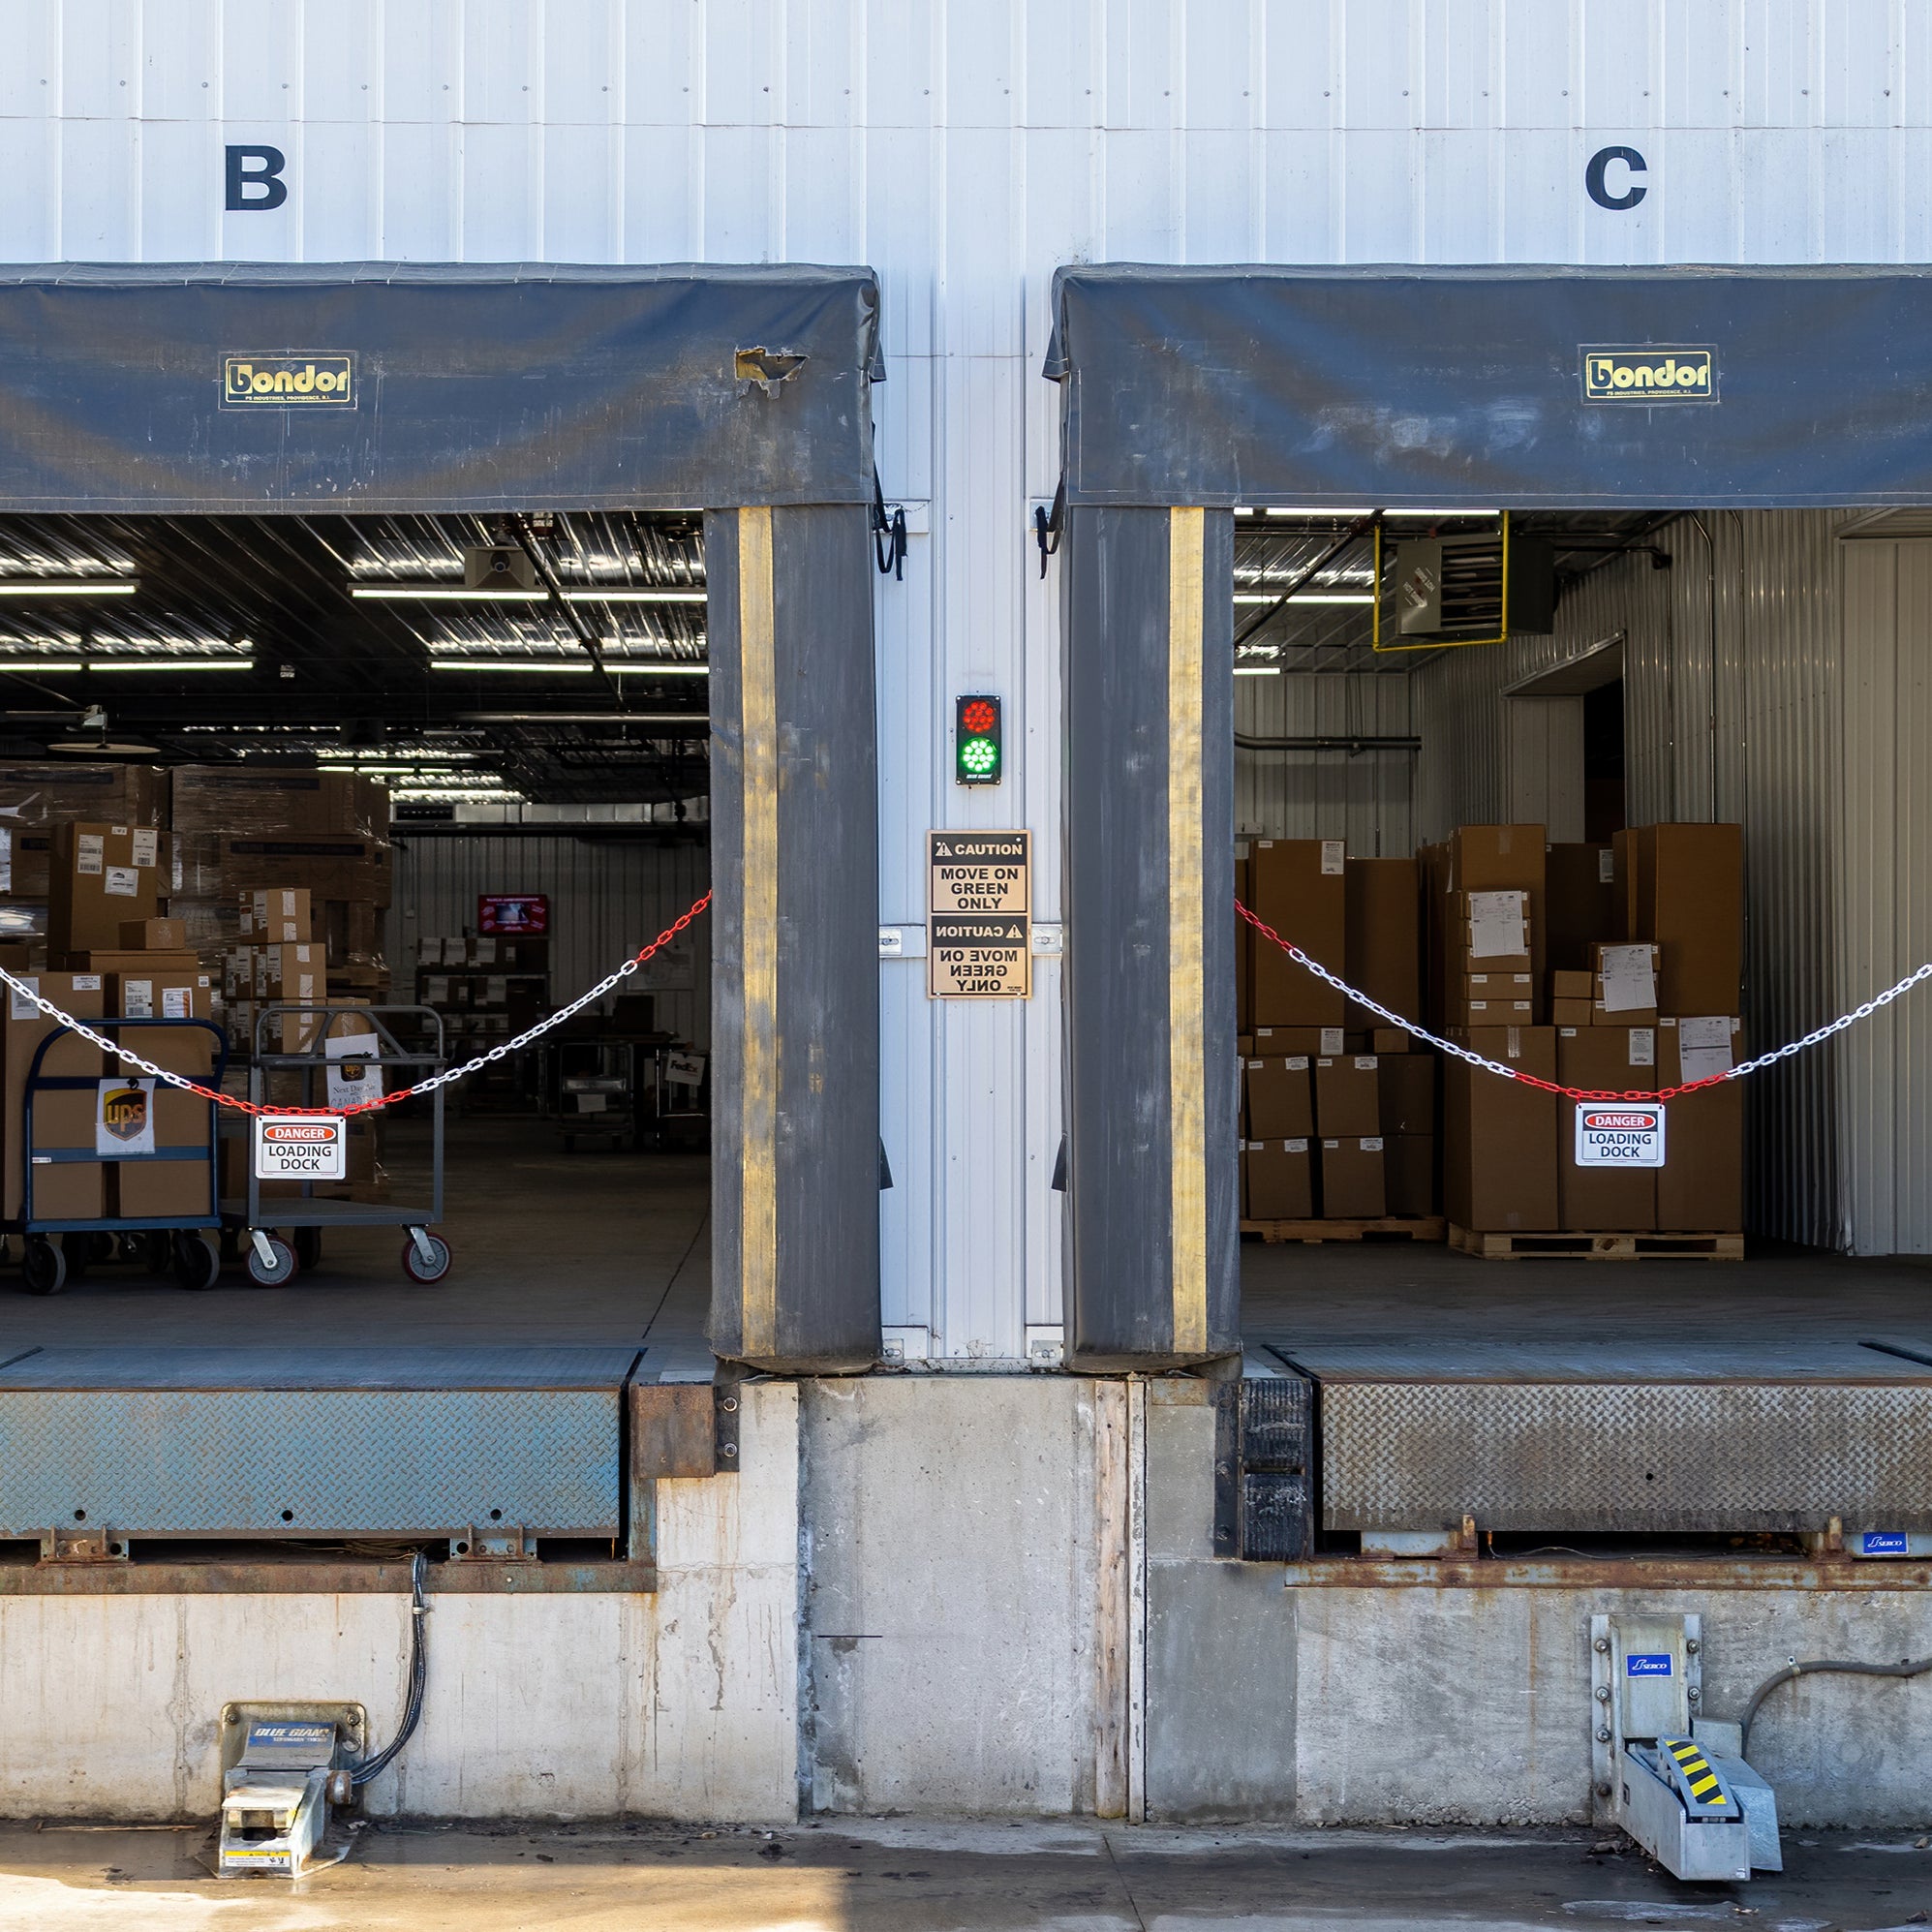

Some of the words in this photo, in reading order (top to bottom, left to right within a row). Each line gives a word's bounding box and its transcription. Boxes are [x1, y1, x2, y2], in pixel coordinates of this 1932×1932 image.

[226, 145, 288, 210] B
[1585, 145, 1648, 210] C
[954, 843, 1023, 855] CAUTION
[940, 868, 989, 880] MOVE
[994, 868, 1019, 880] ON
[951, 882, 1009, 895] GREEN
[957, 897, 1002, 909] ONLY
[107, 1104, 145, 1132] ups
[1595, 1116, 1645, 1126] DANGER
[275, 1128, 325, 1139] DANGER
[1589, 1133, 1652, 1145] LOADING
[268, 1146, 332, 1157] LOADING
[1601, 1147, 1641, 1157] DOCK
[281, 1159, 321, 1171] DOCK
